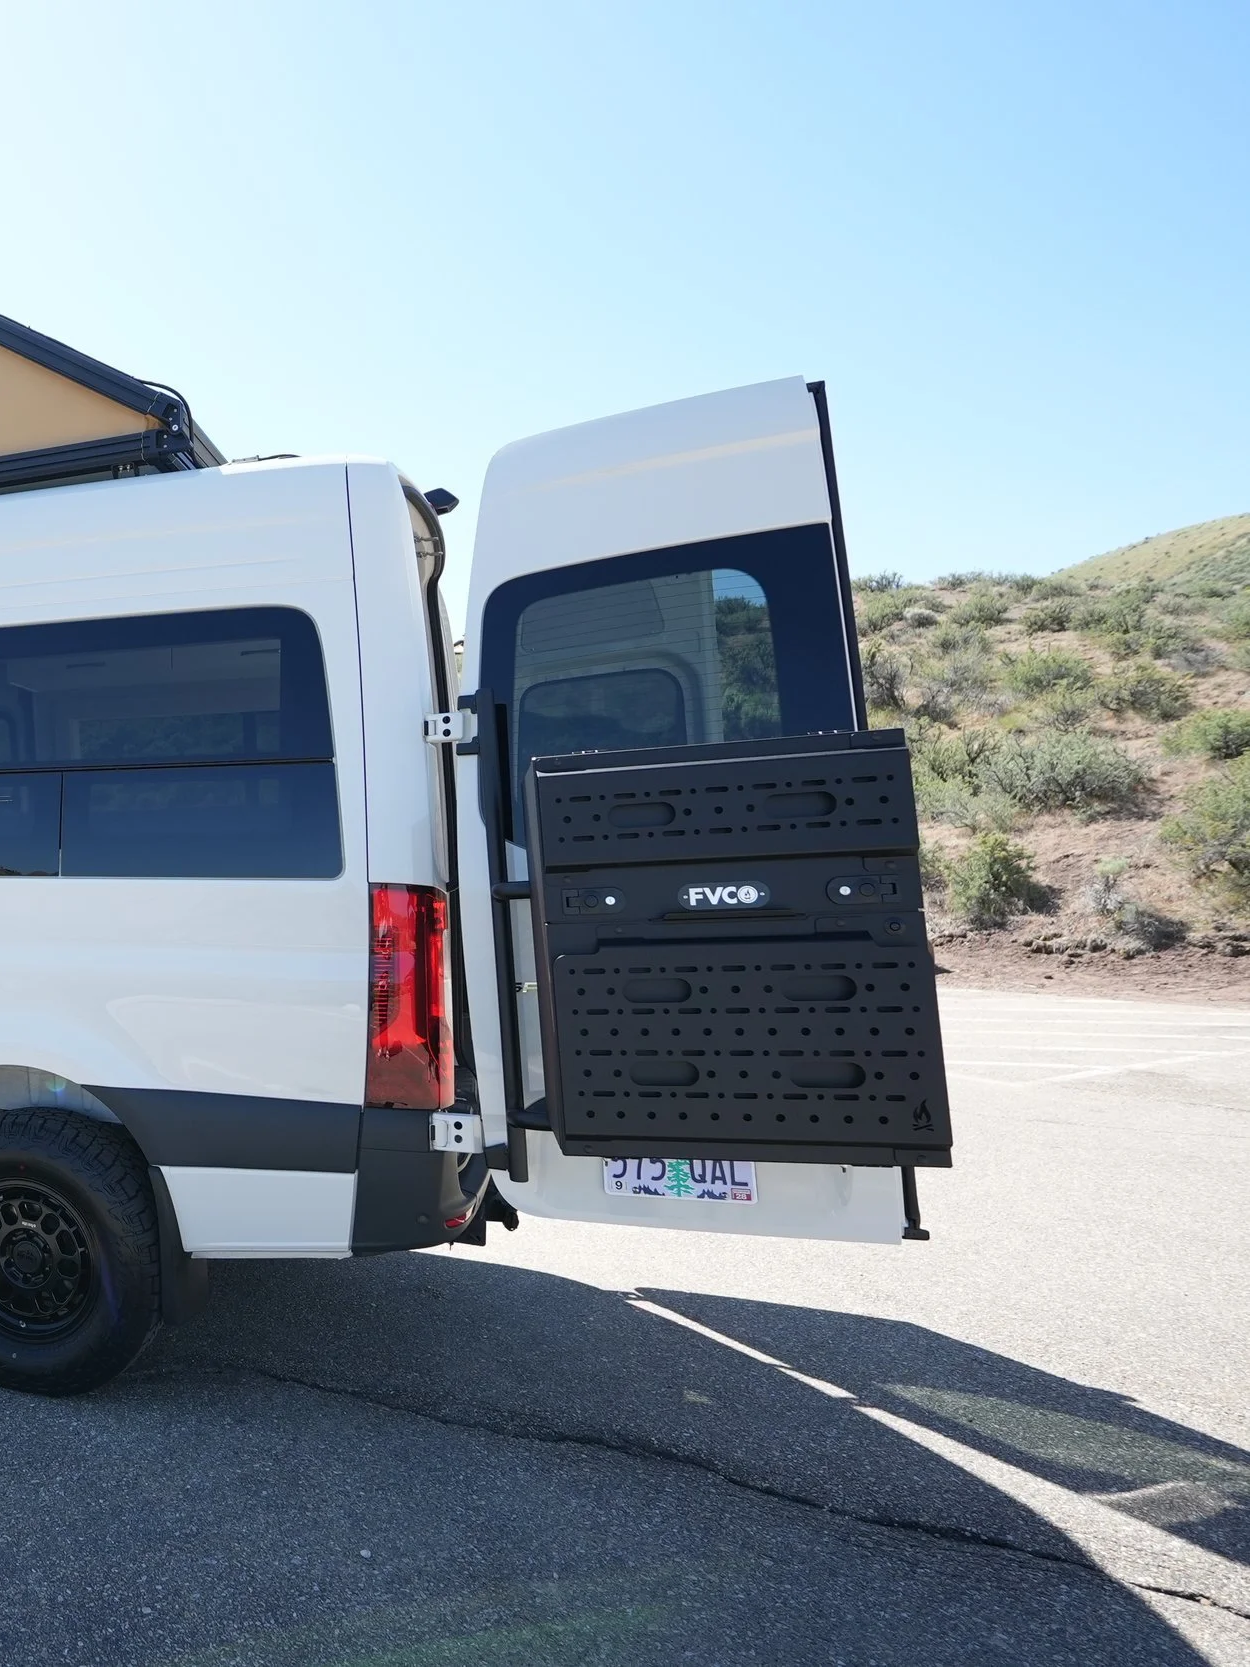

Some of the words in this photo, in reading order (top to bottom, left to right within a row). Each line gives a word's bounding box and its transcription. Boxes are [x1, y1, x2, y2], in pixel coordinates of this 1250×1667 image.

[689, 885, 758, 906] FVCO
[689, 1159, 749, 1187] QAL
[615, 1180, 623, 1190] 9
